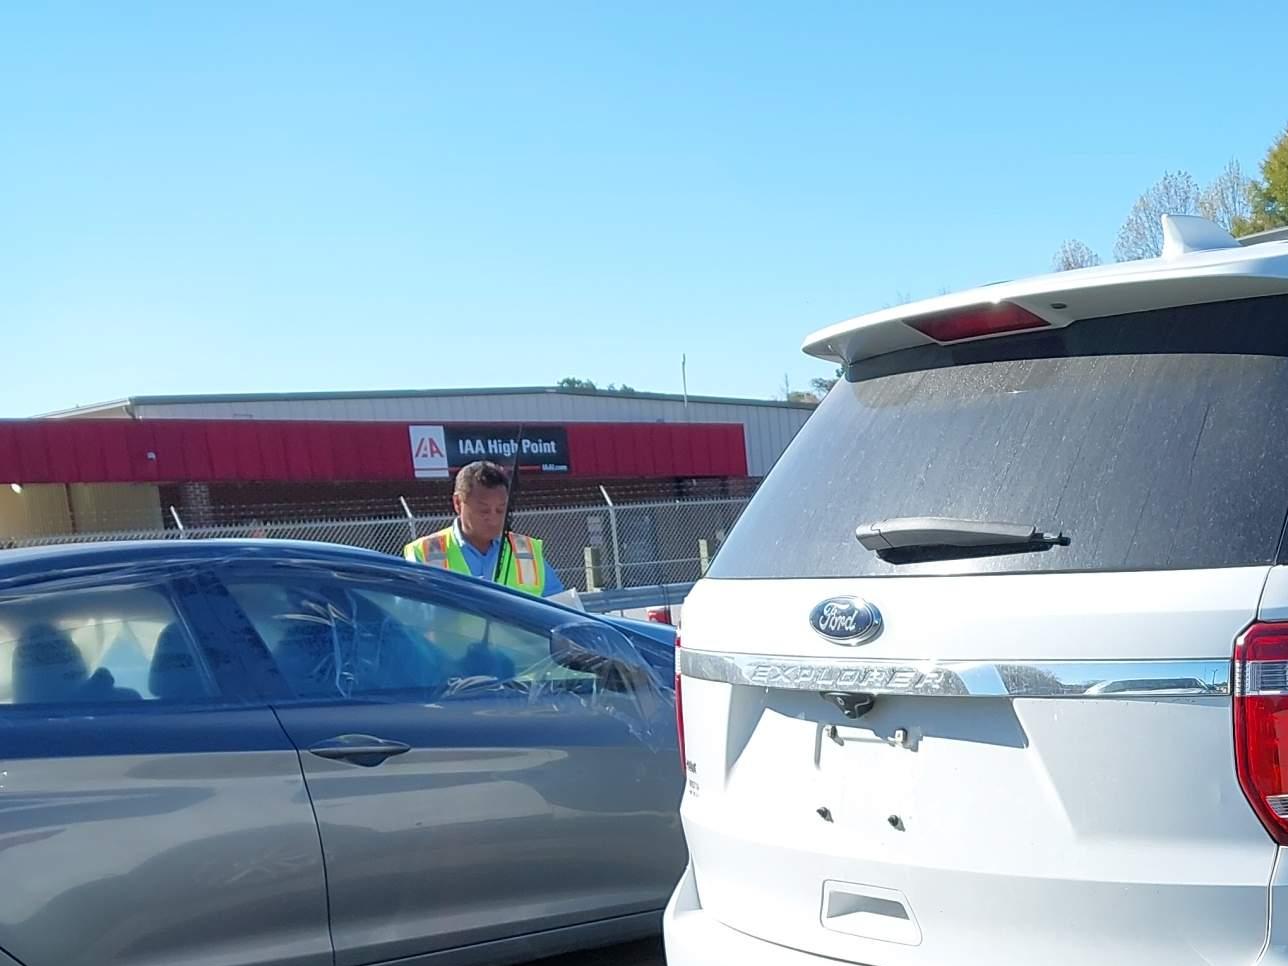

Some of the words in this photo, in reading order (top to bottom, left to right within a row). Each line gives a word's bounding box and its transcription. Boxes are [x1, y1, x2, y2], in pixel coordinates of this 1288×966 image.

[458, 439, 486, 454] IAA
[488, 439, 518, 456] High
[521, 439, 557, 454] Point
[819, 602, 859, 631] Ford
[750, 663, 945, 689] EXPLORER
